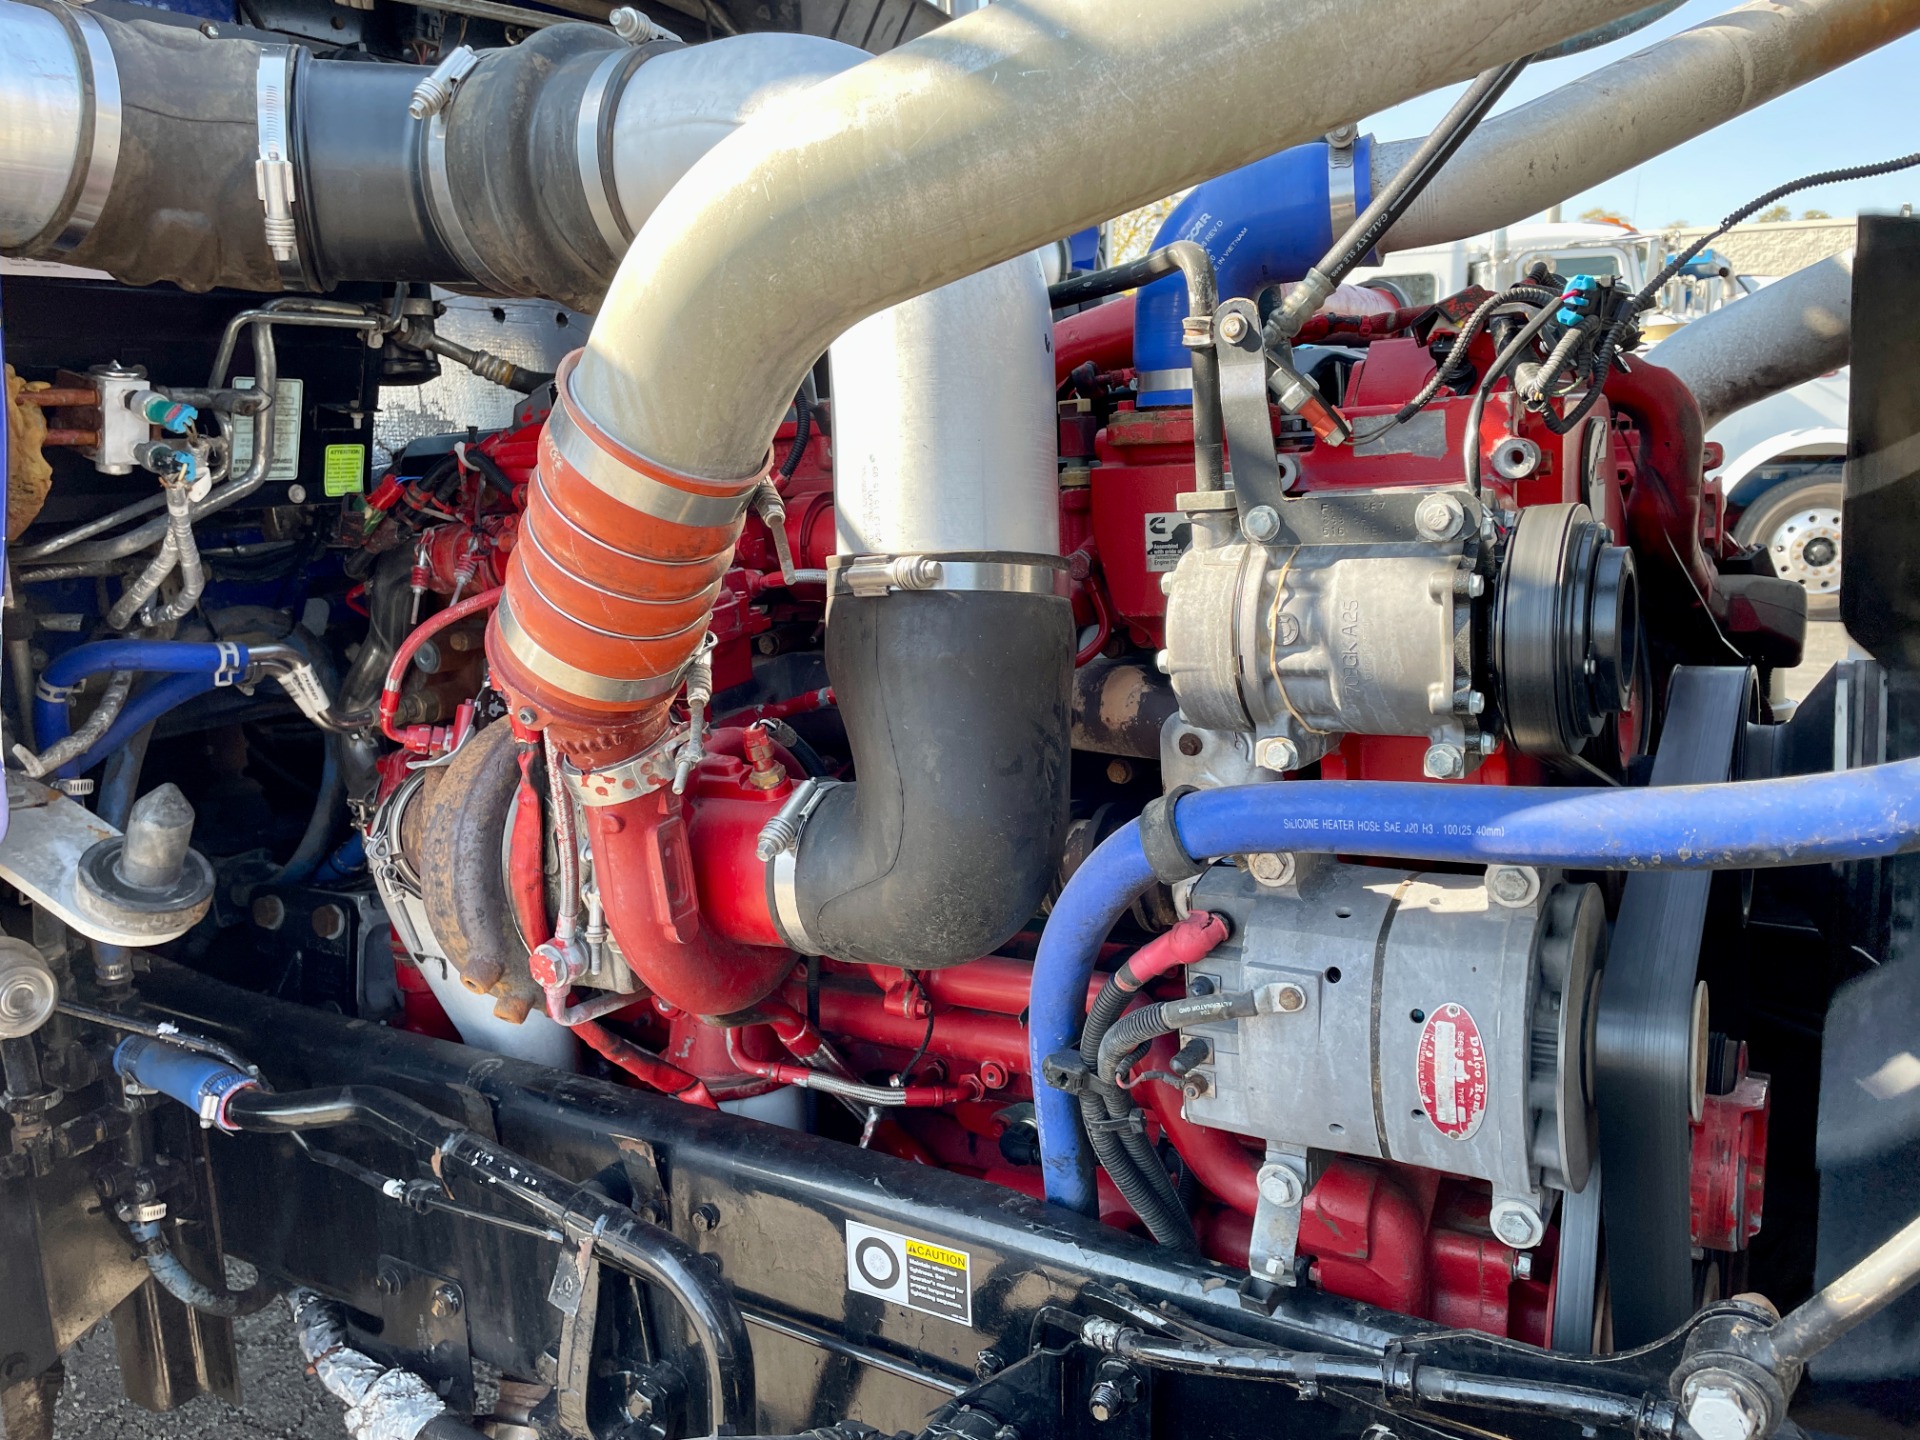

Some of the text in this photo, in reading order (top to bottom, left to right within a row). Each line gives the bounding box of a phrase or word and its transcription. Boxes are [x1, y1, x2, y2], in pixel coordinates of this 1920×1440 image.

[1185, 213, 1212, 241] CCAR
[1205, 226, 1218, 242] REV
[1356, 213, 1388, 251] GALAXY
[1217, 227, 1248, 266] IN VIETNAM
[1343, 249, 1356, 265] SLE
[1283, 818, 1320, 830] SILICONE
[1322, 819, 1354, 831] HEATER
[1357, 820, 1381, 832] HOSE
[1384, 821, 1401, 833] SAE
[1404, 823, 1419, 834] J20
[1192, 1001, 1233, 1010] ALTERNATOR
[1470, 1036, 1484, 1111] Delco Rem
[1457, 1087, 1465, 1104] TYPE
[909, 1258, 931, 1270] Maintain
[917, 1246, 965, 1267] CAUTION
[934, 1273, 946, 1281] See
[910, 1282, 956, 1300] proper torque and
[936, 1282, 956, 1292] manual
